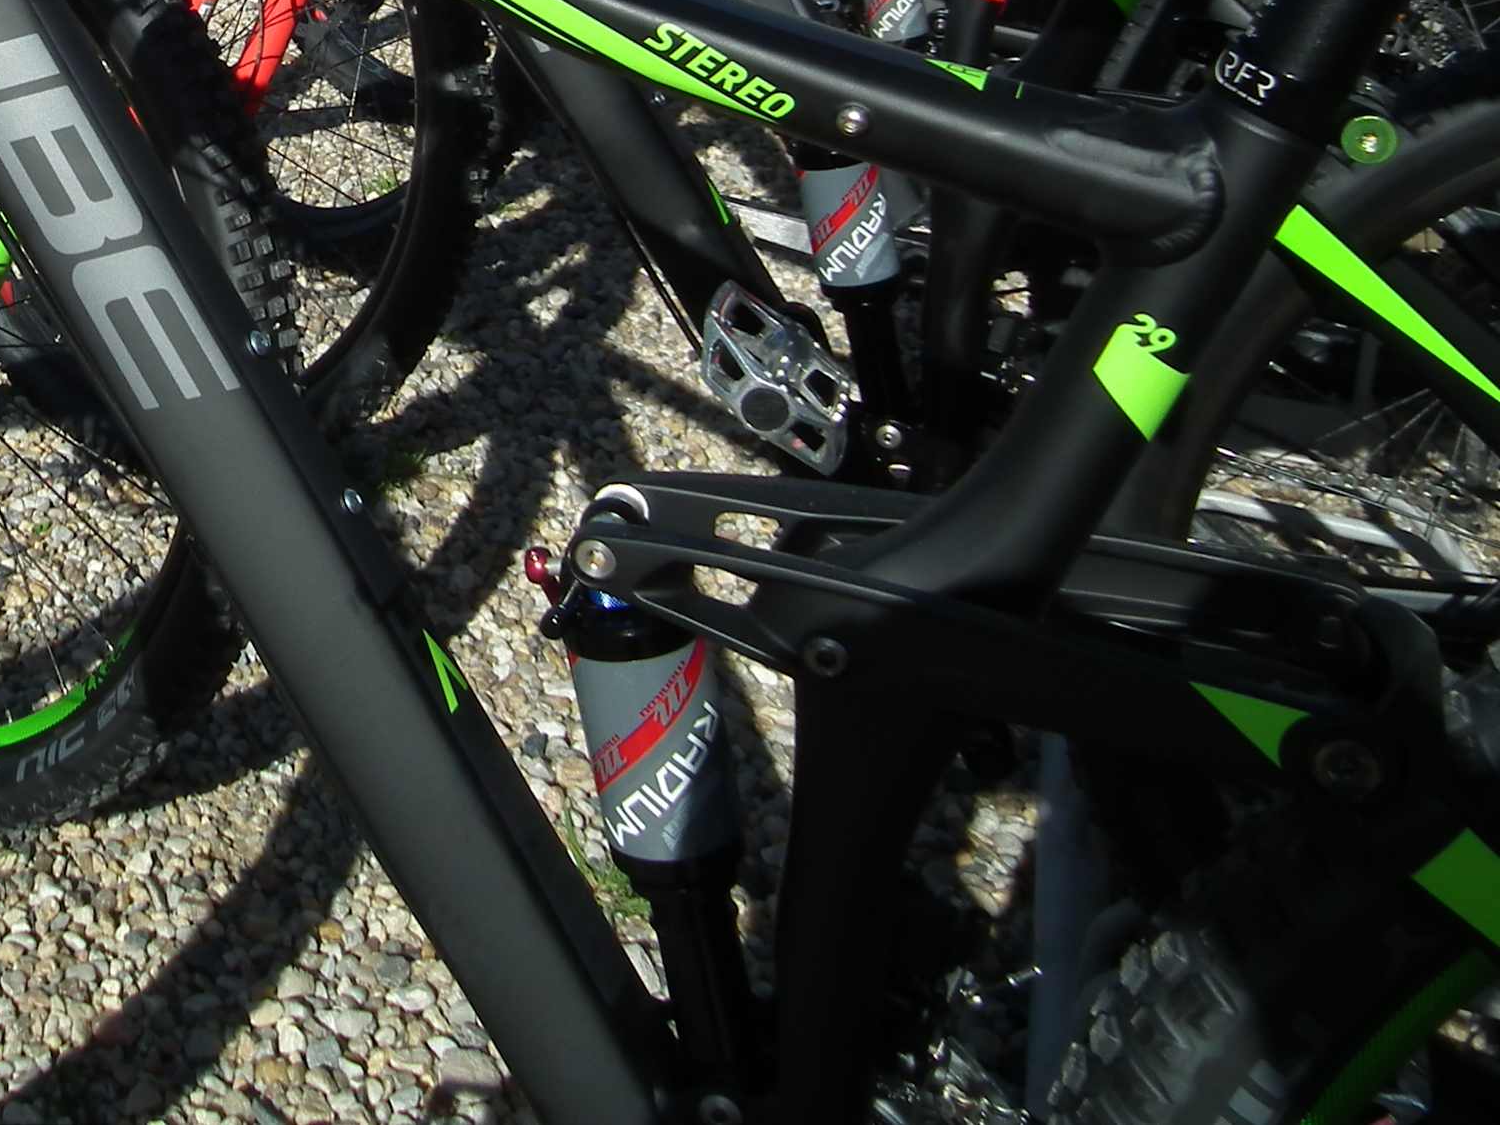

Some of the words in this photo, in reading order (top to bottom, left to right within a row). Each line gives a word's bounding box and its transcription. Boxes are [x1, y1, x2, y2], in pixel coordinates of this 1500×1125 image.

[643, 21, 796, 120] STEREO
[1223, 50, 1276, 99] RFR
[819, 192, 887, 282] RADIUM
[1115, 313, 1178, 354] 29
[604, 700, 719, 848] RADIUM
